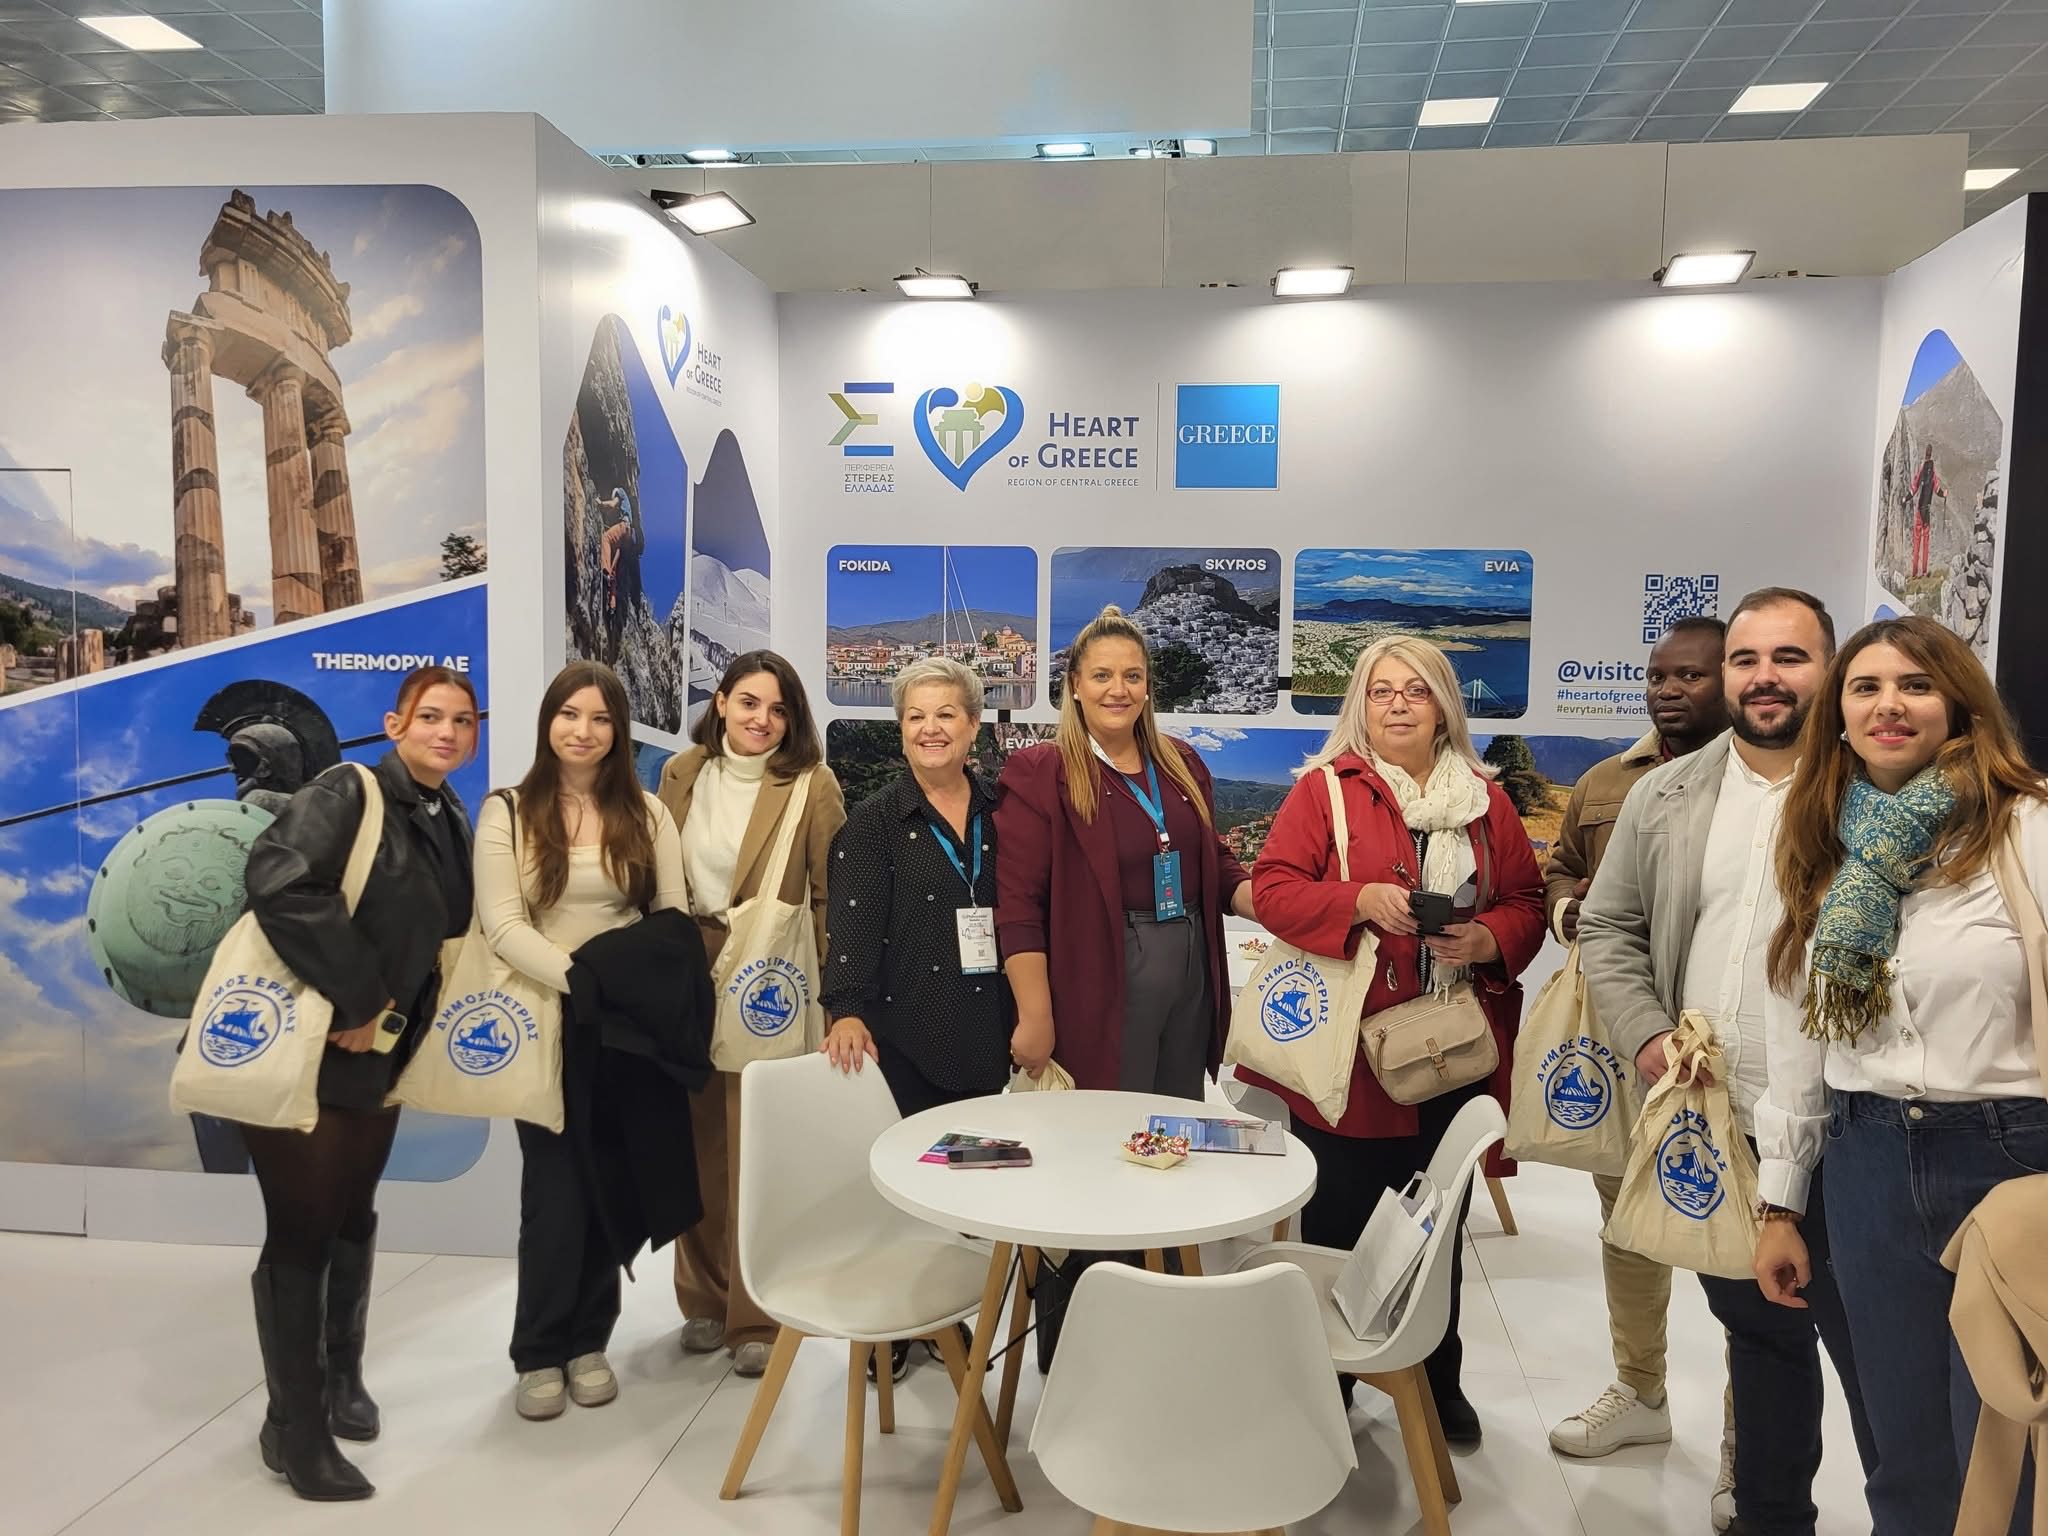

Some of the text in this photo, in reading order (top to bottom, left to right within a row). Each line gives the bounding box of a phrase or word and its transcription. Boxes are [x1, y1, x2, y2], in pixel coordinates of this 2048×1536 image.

[697, 341, 722, 371] HEART
[694, 364, 722, 394] GREECE
[1048, 411, 1140, 437] HEART
[1178, 423, 1277, 445] GREECE
[1008, 442, 1139, 469] OF GREECE
[844, 463, 895, 471] ΠΕΡΙΦΕΡΕΙΑ
[844, 473, 895, 483] ΣΤΕΡΕΑΣ
[1007, 478, 1140, 487] REGION OF CENTRAL GREECE
[844, 484, 895, 493] ΕΛΛΑΔΑΣ
[839, 559, 892, 572] FOKIDA
[1205, 558, 1267, 571] SKYROS
[1484, 560, 1520, 572] EVIA
[1556, 704, 1649, 716] #evrytania #vioti
